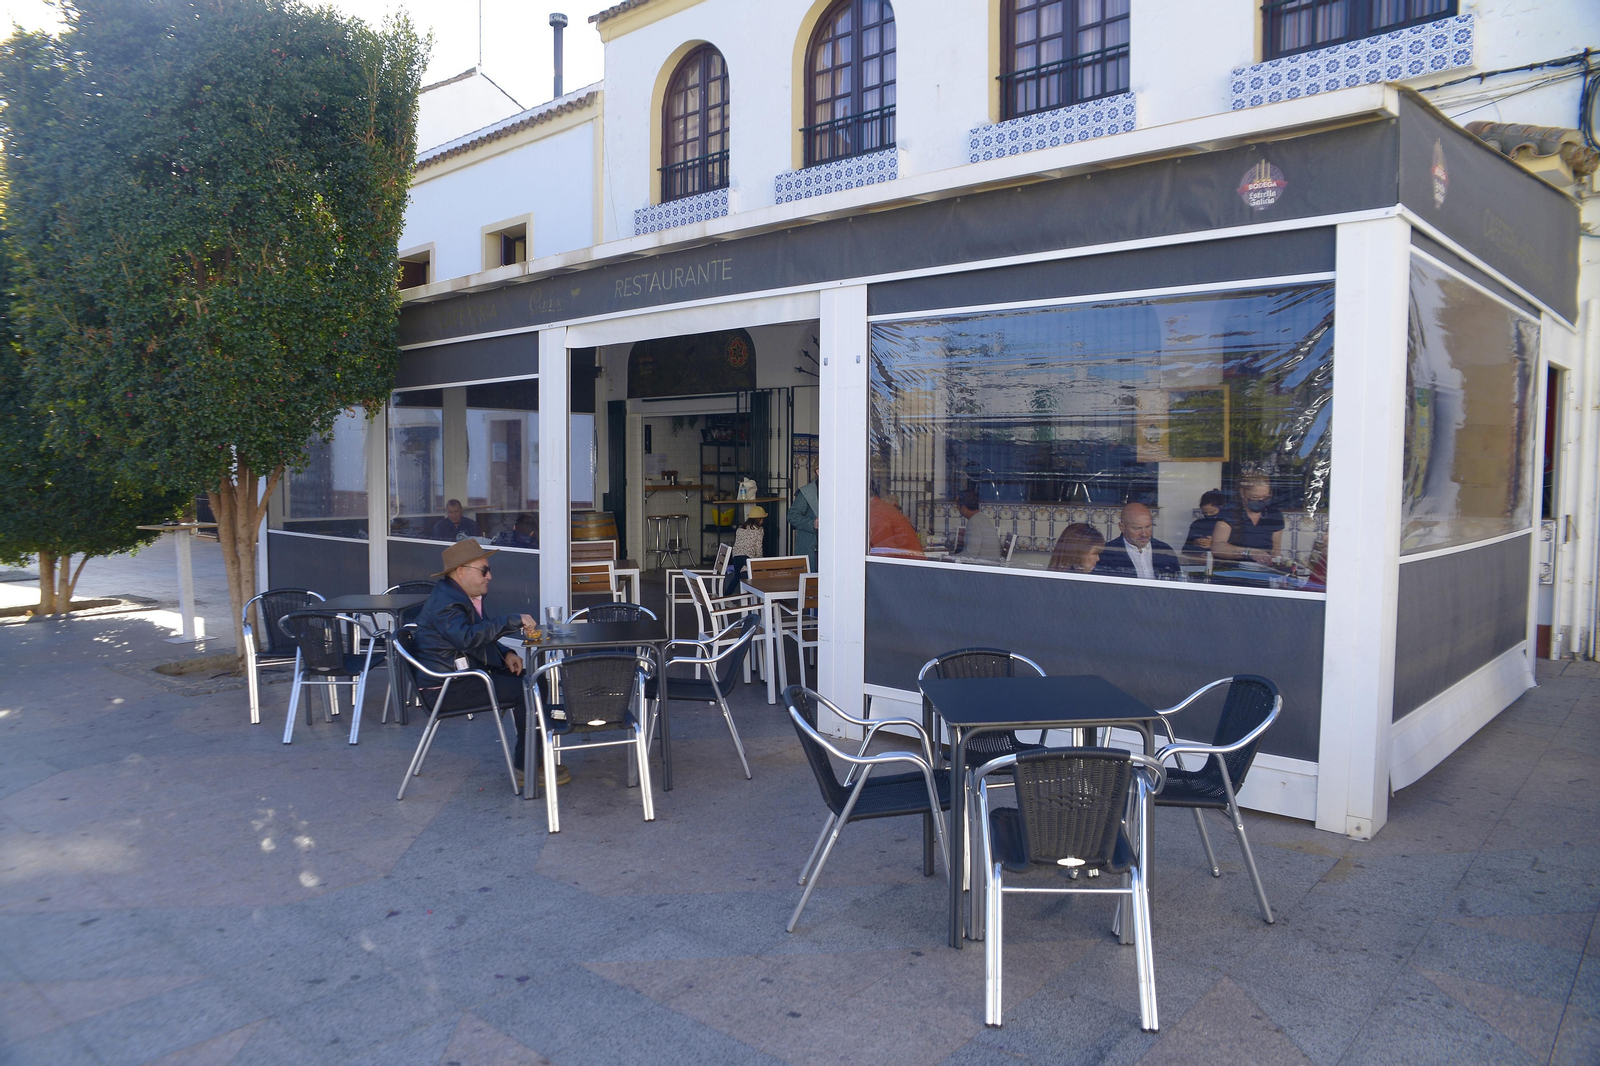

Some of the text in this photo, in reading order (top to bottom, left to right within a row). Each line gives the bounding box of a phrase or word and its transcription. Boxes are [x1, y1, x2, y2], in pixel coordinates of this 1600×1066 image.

[1248, 181, 1278, 191] BODEGA
[1248, 190, 1277, 200] Estrella
[1249, 197, 1275, 207] Galicia
[614, 258, 733, 299] RESTAURANTE
